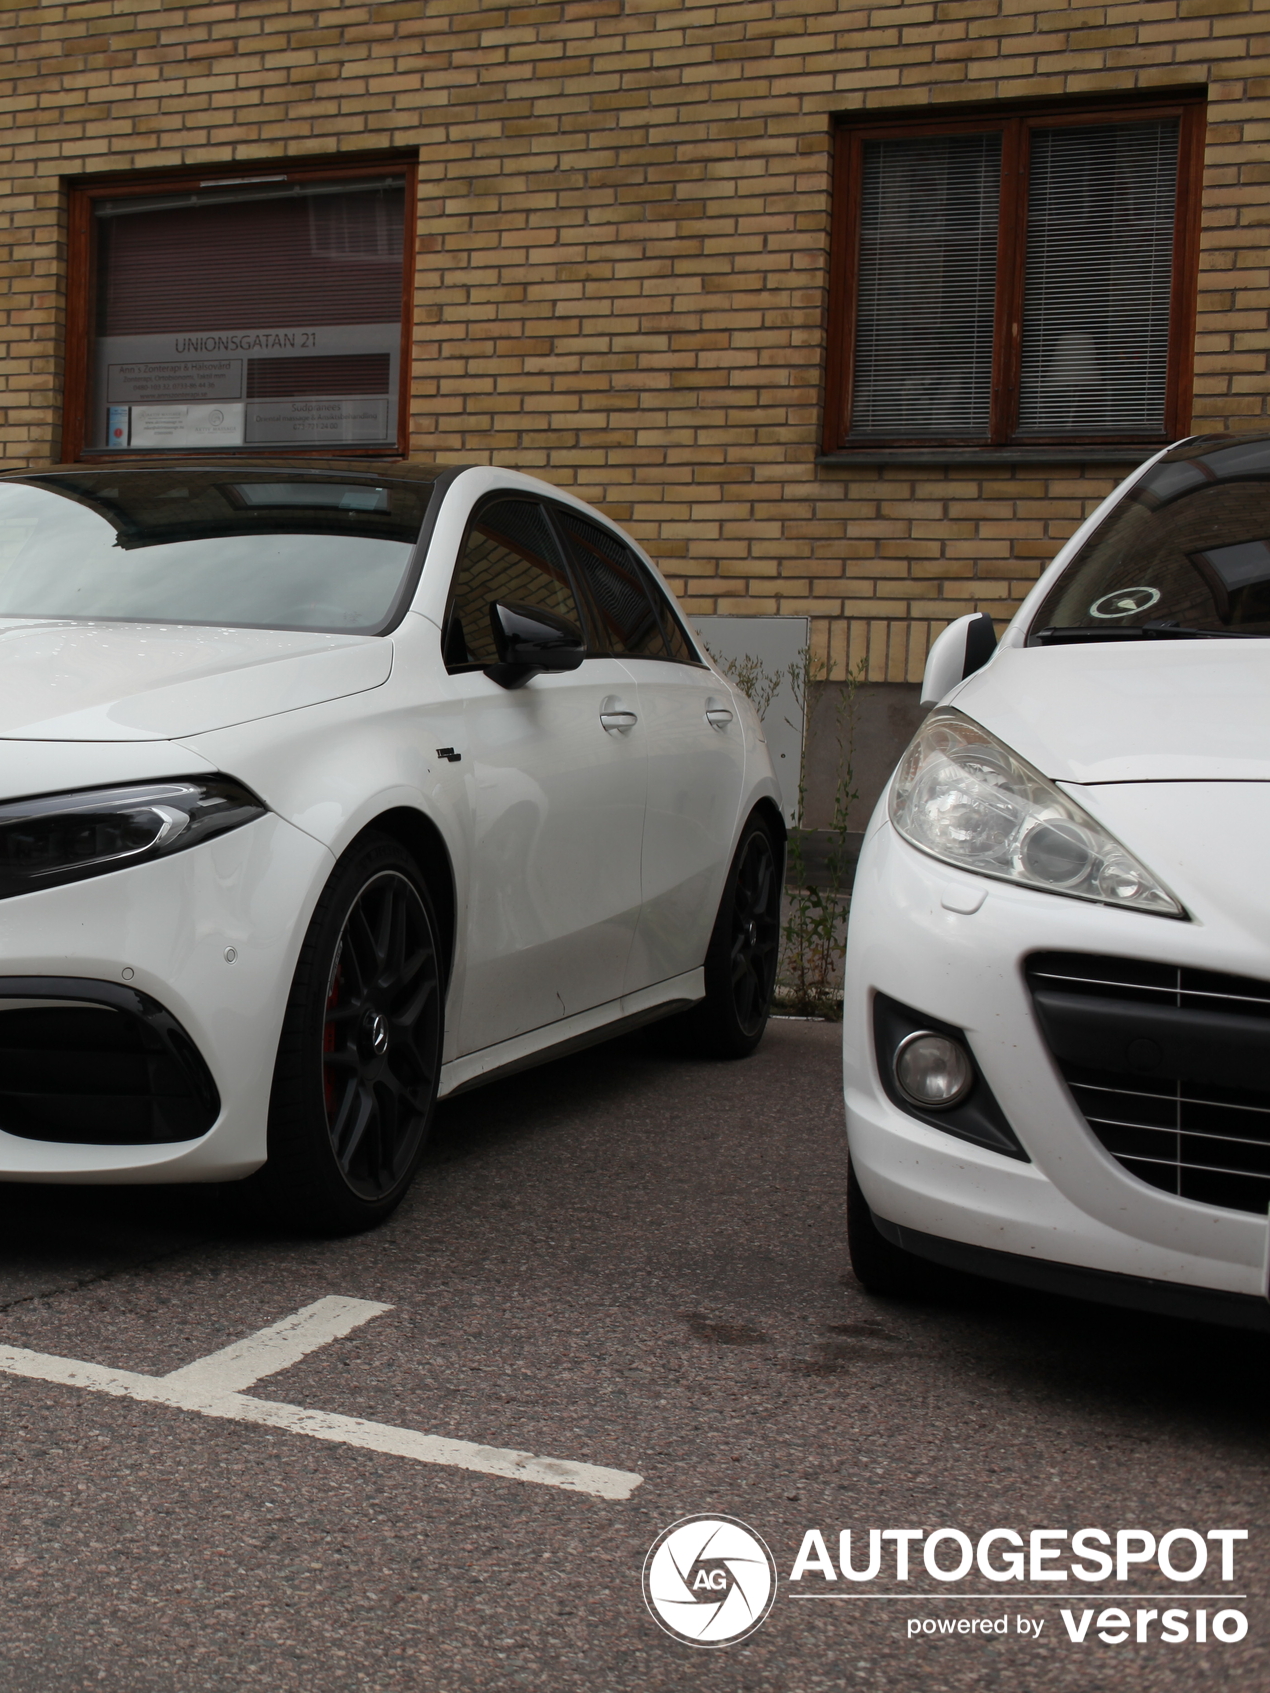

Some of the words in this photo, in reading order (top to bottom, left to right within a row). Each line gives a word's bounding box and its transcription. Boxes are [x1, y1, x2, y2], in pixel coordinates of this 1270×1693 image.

[175, 333, 295, 353] UNIONSGATAN
[300, 332, 317, 348] 21
[143, 363, 182, 373] Zonterapi
[183, 363, 190, 371] &
[256, 414, 281, 422] Oriental
[282, 414, 310, 423] massage
